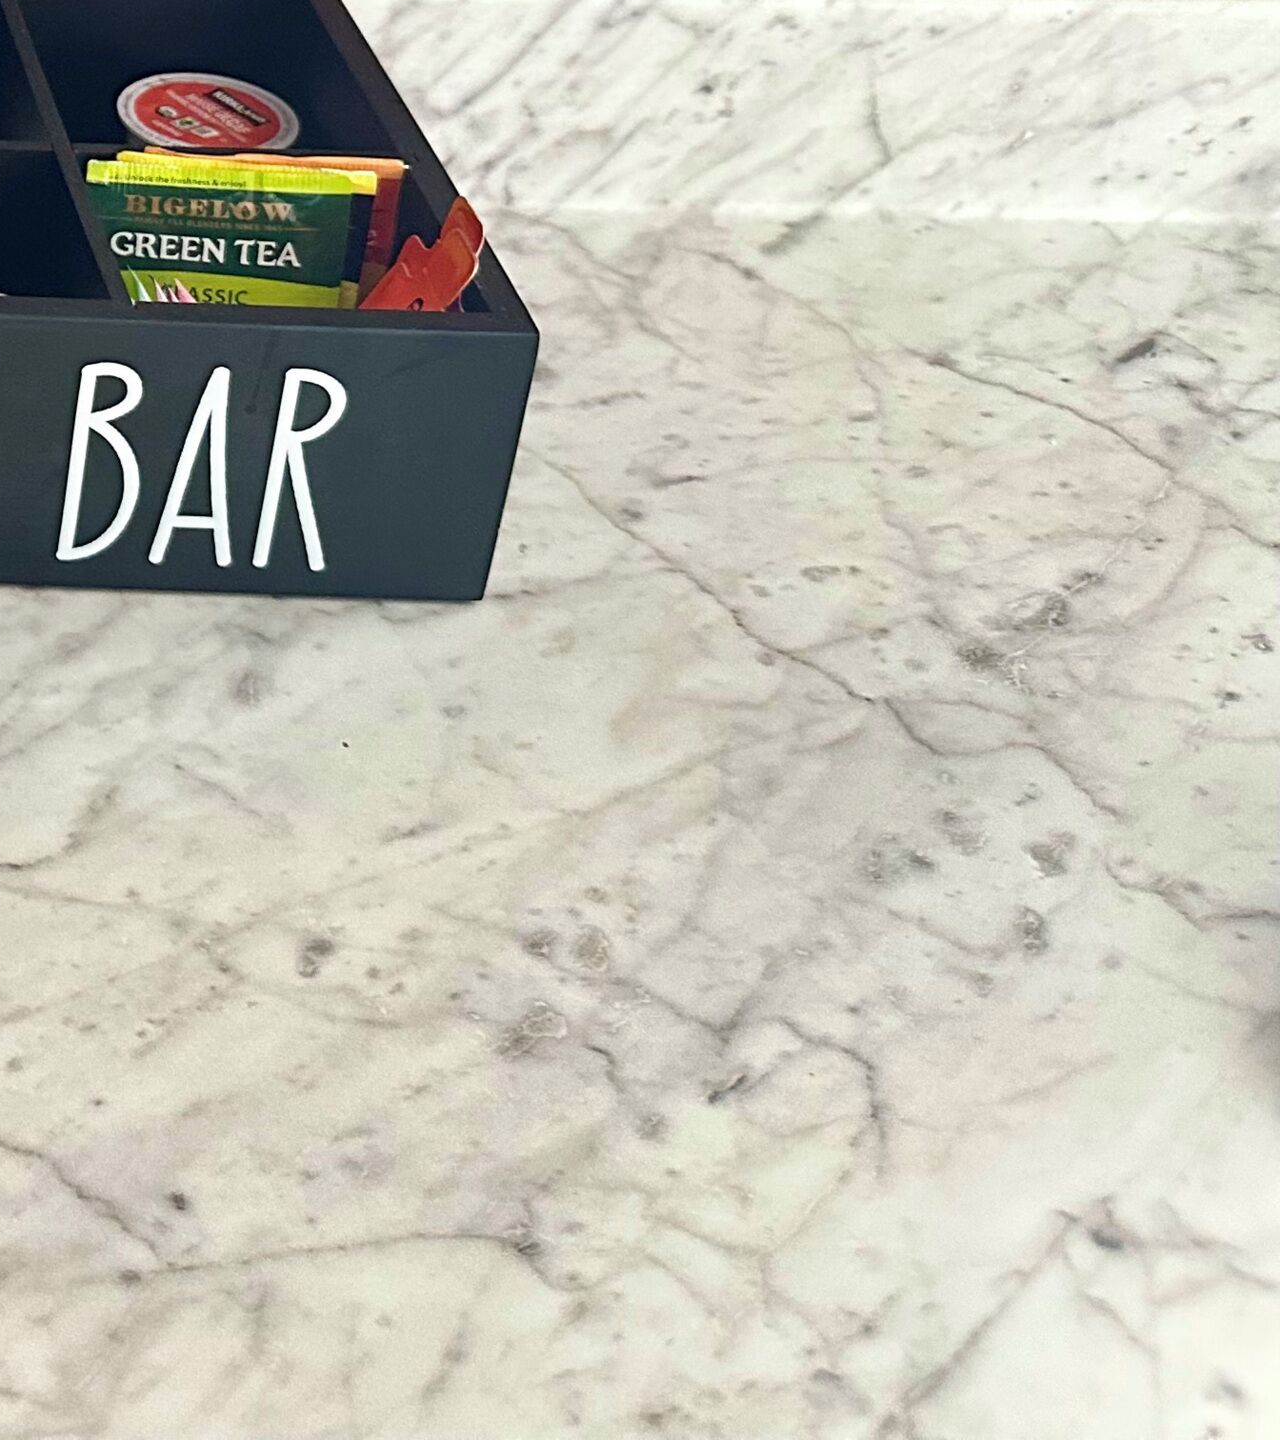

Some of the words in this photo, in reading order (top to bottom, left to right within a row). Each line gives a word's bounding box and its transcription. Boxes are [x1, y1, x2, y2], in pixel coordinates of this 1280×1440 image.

[125, 194, 297, 222] BIGELOW
[110, 231, 226, 264] GREEN
[233, 239, 302, 267] TEA
[161, 282, 248, 305] ASSIC
[55, 361, 348, 572] BAR
